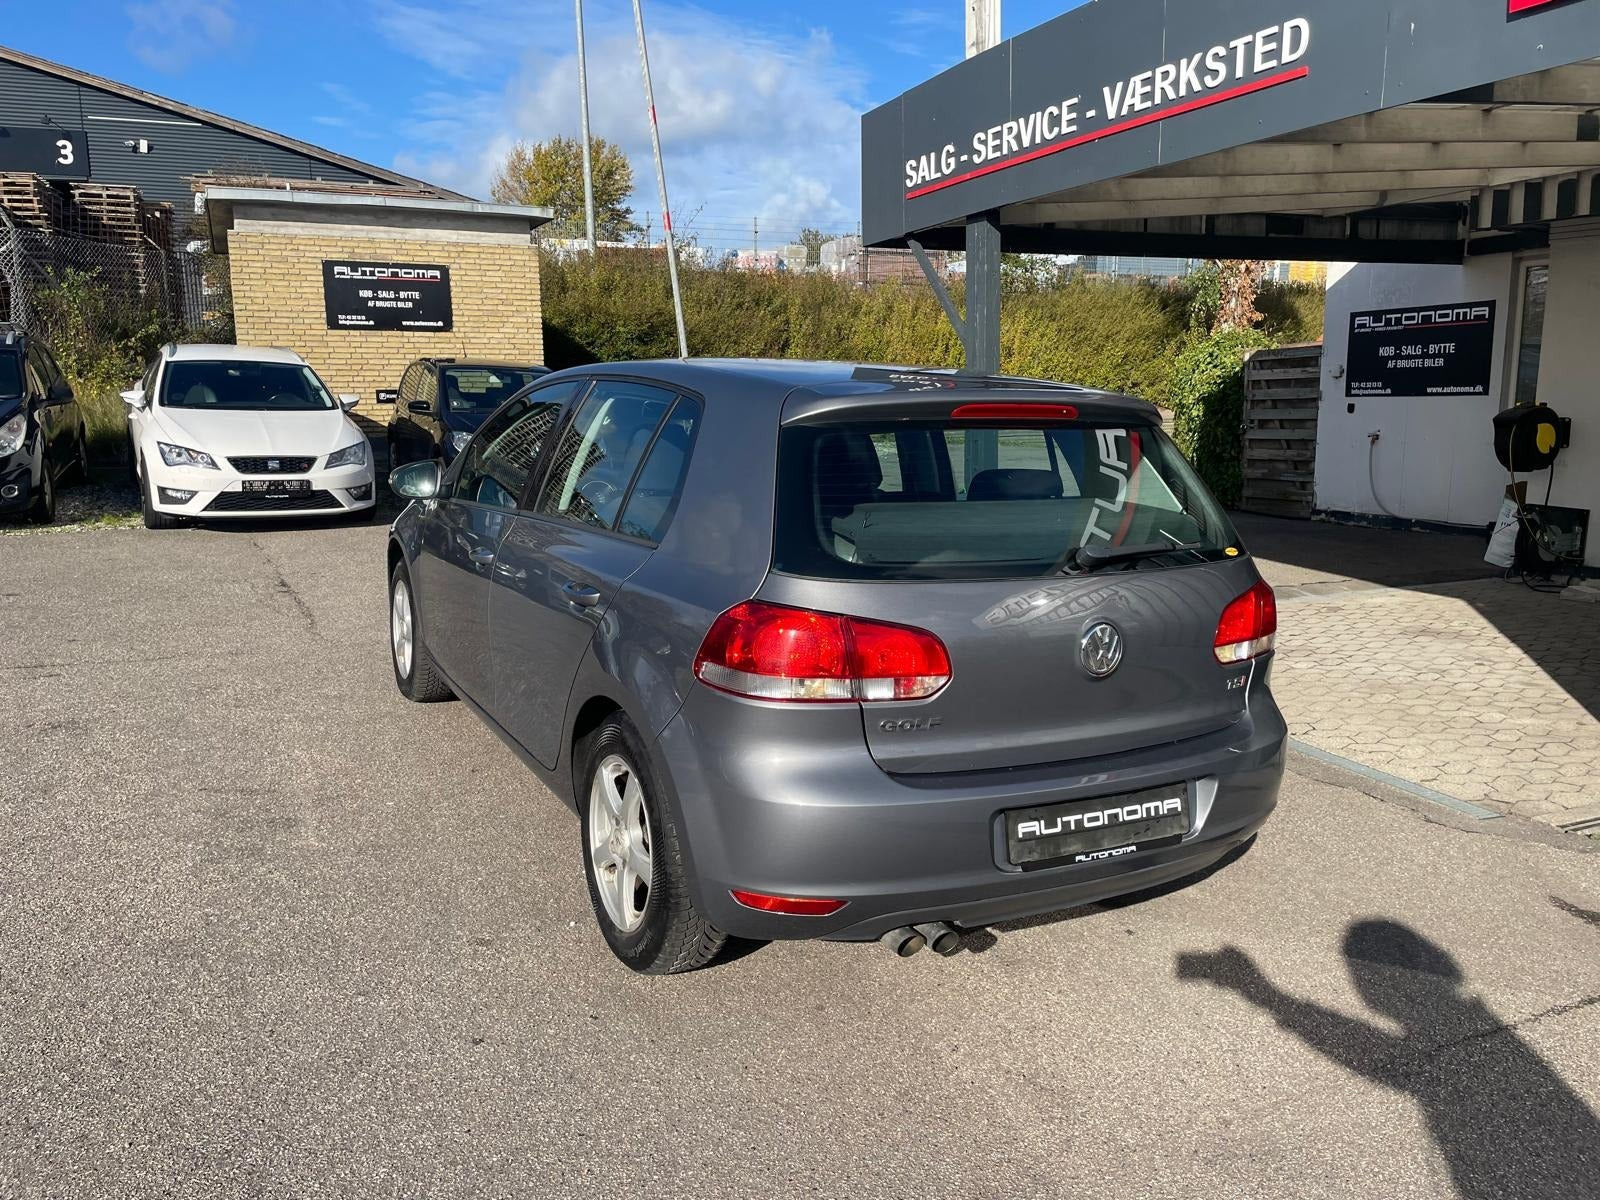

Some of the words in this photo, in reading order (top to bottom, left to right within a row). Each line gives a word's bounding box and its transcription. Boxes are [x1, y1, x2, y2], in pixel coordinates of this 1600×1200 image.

[905, 144, 956, 187] SALG
[972, 97, 1079, 164] SERVICE
[1102, 17, 1310, 120] VÆRKSTED
[55, 139, 74, 165] 3
[333, 265, 441, 279] AUTONOMA
[377, 291, 395, 299] SALG
[399, 291, 420, 300] BYTTE
[1354, 306, 1489, 328] AUTONOMA
[1379, 346, 1394, 357] KØB
[1401, 344, 1421, 356] SALG
[1428, 342, 1455, 354] BYTTE
[1387, 359, 1396, 368] AF
[1396, 358, 1423, 368] BRUGTE
[1424, 358, 1444, 367] BILER
[1426, 384, 1484, 393] www.autonoma.dk
[879, 717, 943, 733] GOLF
[1017, 797, 1182, 838] AUTONOMA
[1075, 845, 1137, 862] AUTONOMA
